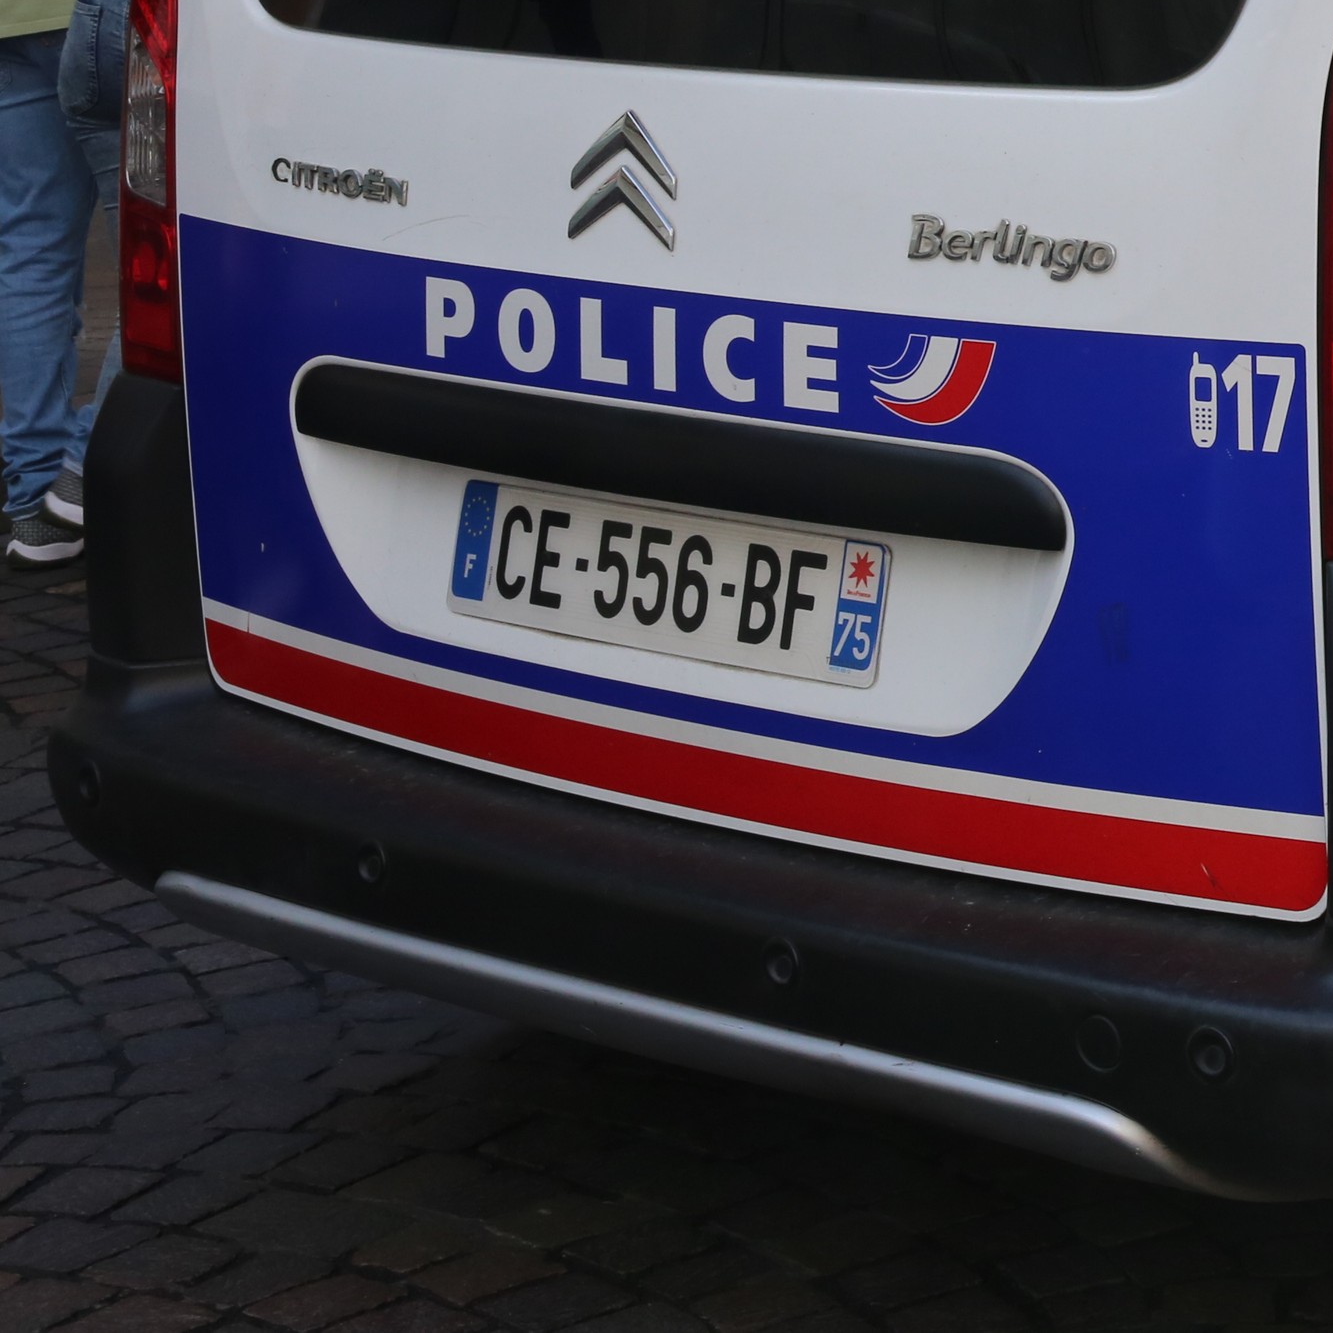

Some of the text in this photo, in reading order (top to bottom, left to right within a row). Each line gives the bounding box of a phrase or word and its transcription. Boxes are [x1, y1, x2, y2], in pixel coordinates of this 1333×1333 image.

[271, 157, 409, 207] CITROËN
[907, 214, 1117, 281] Berlingo
[425, 276, 840, 413] POLICE
[1221, 354, 1296, 453] 17
[463, 553, 478, 578] F
[495, 505, 828, 650] CE-556-BF
[833, 611, 873, 661] 75
